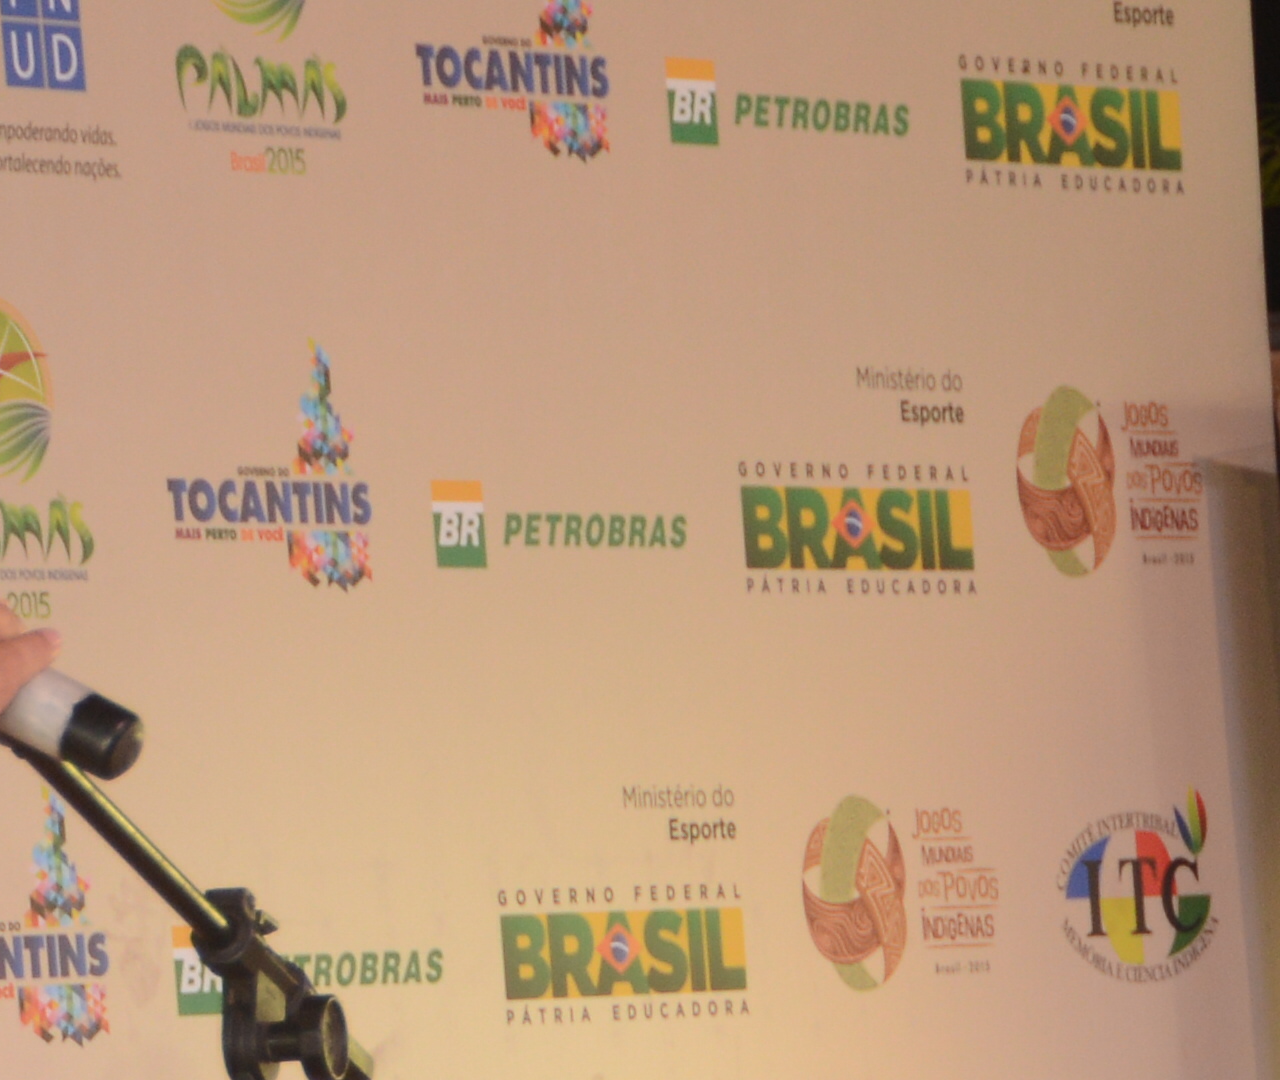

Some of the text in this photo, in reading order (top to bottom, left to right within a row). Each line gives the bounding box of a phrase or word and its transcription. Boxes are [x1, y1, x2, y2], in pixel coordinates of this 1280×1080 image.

[1114, 1, 1175, 28] Esporte
[175, 42, 347, 124] PALMAS
[416, 43, 610, 98] TOCANTINS
[958, 54, 1178, 84] GOVERNO FEDERAL
[672, 89, 911, 138] BR PETROBRAS
[961, 79, 1183, 171] BRASIL
[966, 168, 1185, 196] PÁTRIA EDUCADORA
[856, 366, 964, 392] Ministério do
[900, 399, 965, 426] Esporte
[1122, 401, 1169, 431] JOGOS
[738, 460, 969, 483] GOVERNO FEDERAL
[1145, 464, 1204, 496] POVOS
[167, 477, 372, 525] TOCANTINS
[175, 528, 202, 541] MAIS
[204, 528, 237, 541] PERTO
[437, 511, 688, 549] BR PETROBRAS
[741, 485, 975, 571] BRASIL
[746, 574, 977, 596] PÁTRIA EDUCADORA
[622, 785, 735, 808] Ministério do
[668, 817, 736, 844] Esporte
[912, 807, 962, 839] JOGOS
[498, 883, 742, 906] GOVERNO FEDERAL
[937, 870, 999, 902] POVOS
[1082, 856, 1199, 937] ITC
[500, 907, 747, 1000] BRASIL
[506, 999, 750, 1025] PÁTRIA EDUCADORA
